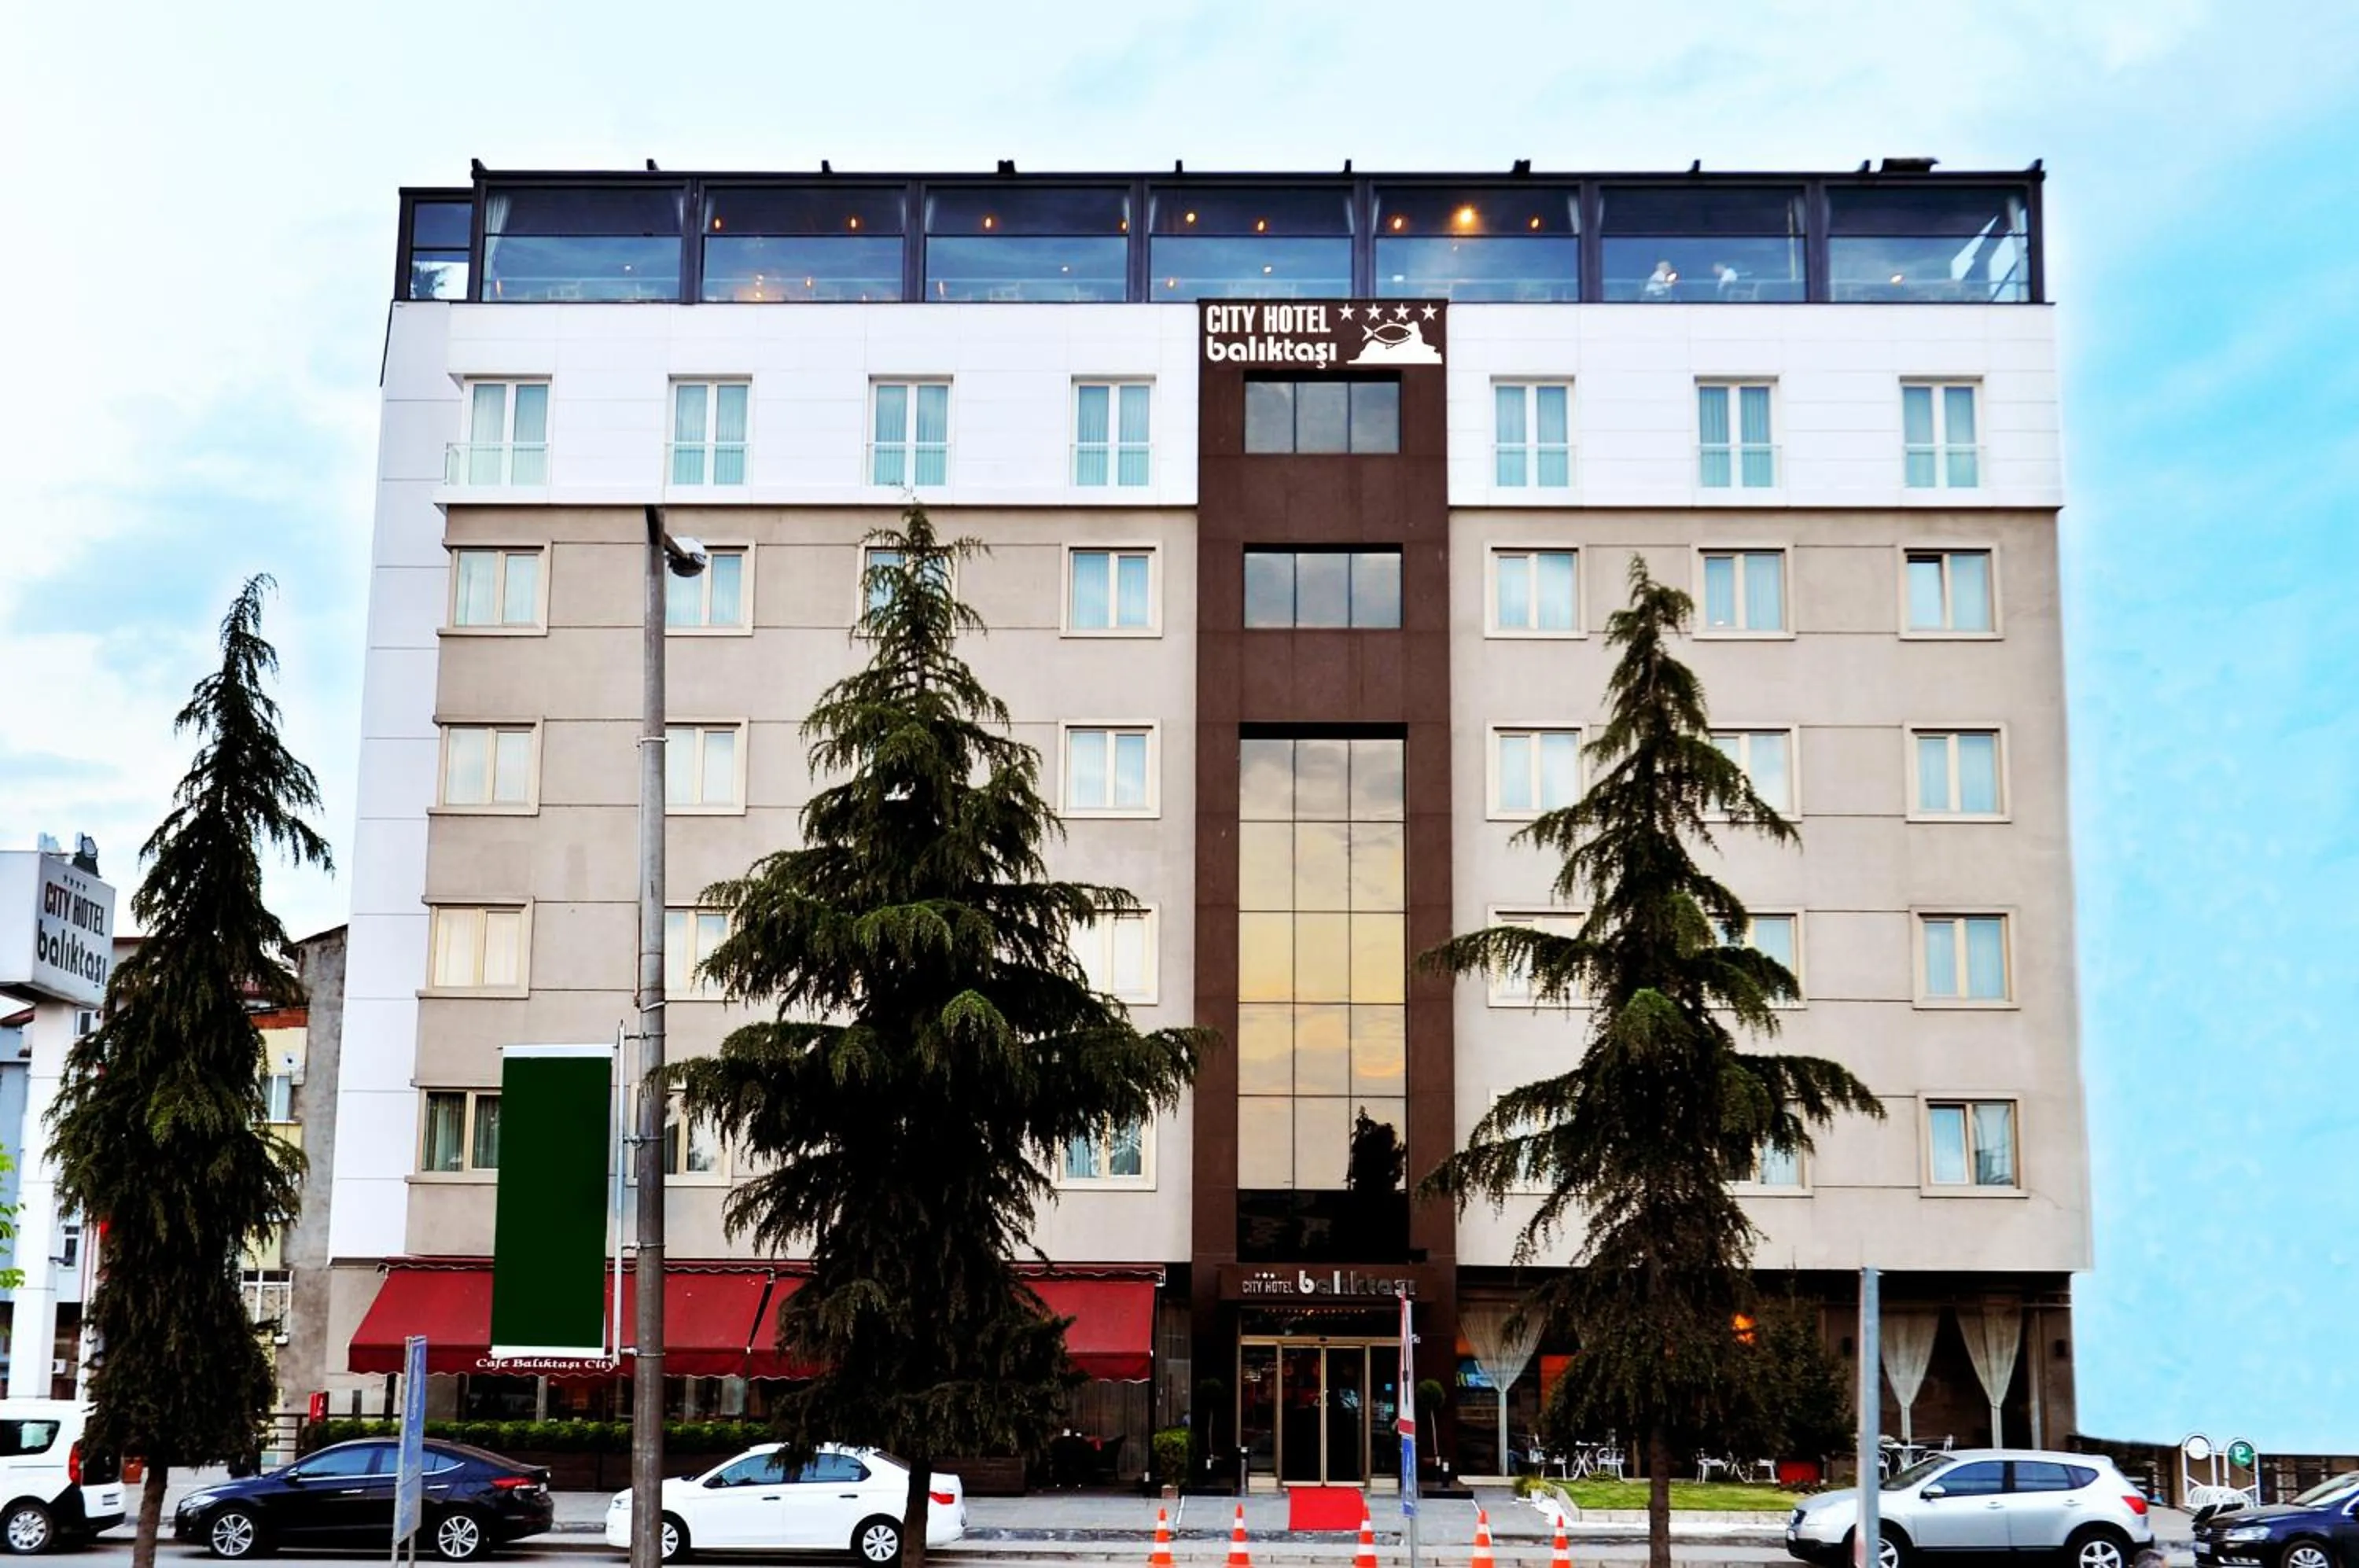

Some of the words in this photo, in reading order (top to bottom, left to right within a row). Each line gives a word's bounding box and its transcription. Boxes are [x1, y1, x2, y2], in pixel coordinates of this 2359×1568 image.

[1206, 305, 1256, 333] CITY
[1264, 305, 1331, 333] HOTEL
[1206, 336, 1337, 369] balıktaşı
[45, 880, 72, 921] CITY
[72, 894, 105, 937] HOTEL
[37, 918, 107, 988] balıktaşı
[1242, 1280, 1262, 1294] CITY
[1265, 1280, 1294, 1294] HOTEL
[476, 1358, 509, 1371] Cafe
[512, 1358, 580, 1370] Balıktaşı
[584, 1359, 616, 1372] City
